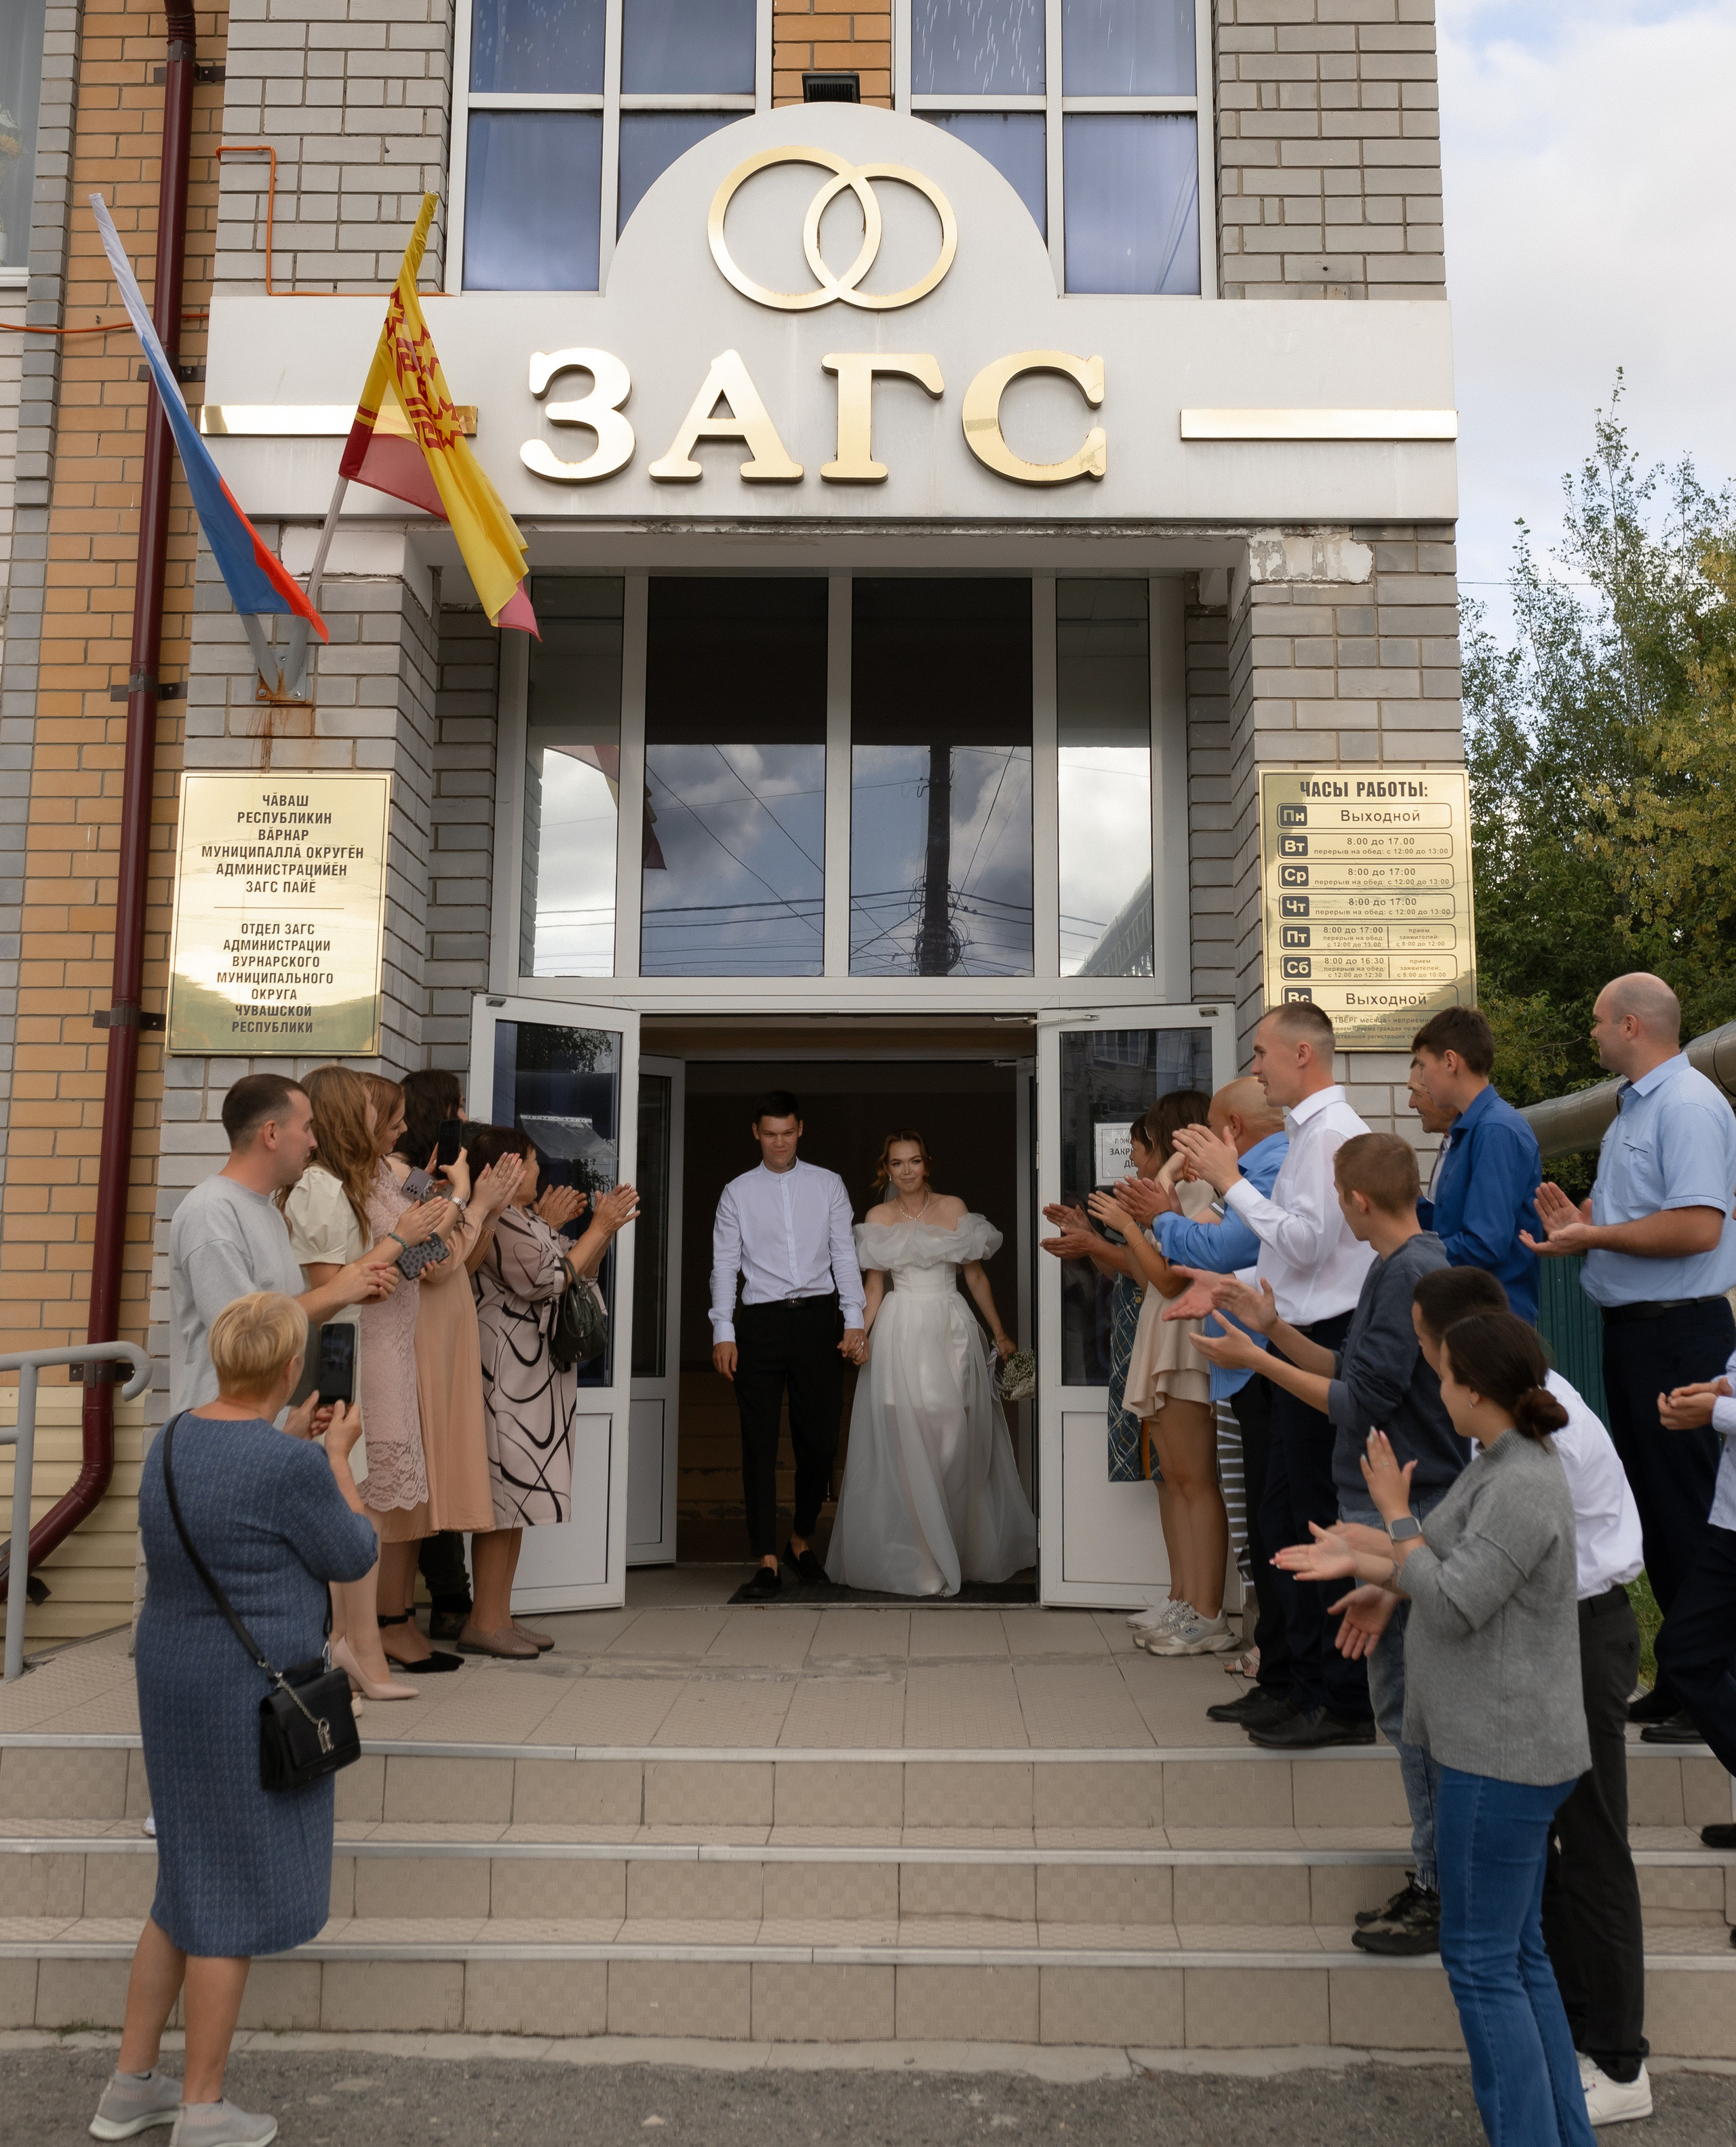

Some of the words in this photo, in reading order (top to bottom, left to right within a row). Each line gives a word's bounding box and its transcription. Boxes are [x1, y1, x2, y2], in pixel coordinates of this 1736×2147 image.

[519, 347, 1107, 487] ЗАГС
[1300, 781, 1349, 797] ЧАСЫ
[1356, 781, 1428, 797] РАБОТЫ:
[237, 812, 332, 824] РЕСПУБЛИКИН
[1283, 810, 1305, 822] Пн
[1340, 809, 1421, 823] Выходной
[1284, 840, 1305, 852] Вт
[1284, 869, 1307, 883] Ср
[246, 881, 278, 893] ЗАГС
[1286, 900, 1306, 913] Чт
[1349, 898, 1370, 906] 8:00
[241, 923, 280, 936] ОТДЕЛ
[285, 923, 315, 934] ЗАГС
[1287, 930, 1307, 943] Пт
[223, 939, 331, 953] АДМИНИСТРАЦИИ
[233, 956, 320, 968] ВУРНАРСКОГО
[1286, 961, 1309, 974] Сб
[216, 972, 334, 985] МУНИЦИПАЛЬНОГО
[251, 989, 297, 1000] ОКРУГА
[1346, 992, 1427, 1006] Выходной
[235, 1003, 312, 1017] ЧУВАШСКОЙ
[232, 1021, 313, 1033] РЕСПУБЛИКИ
